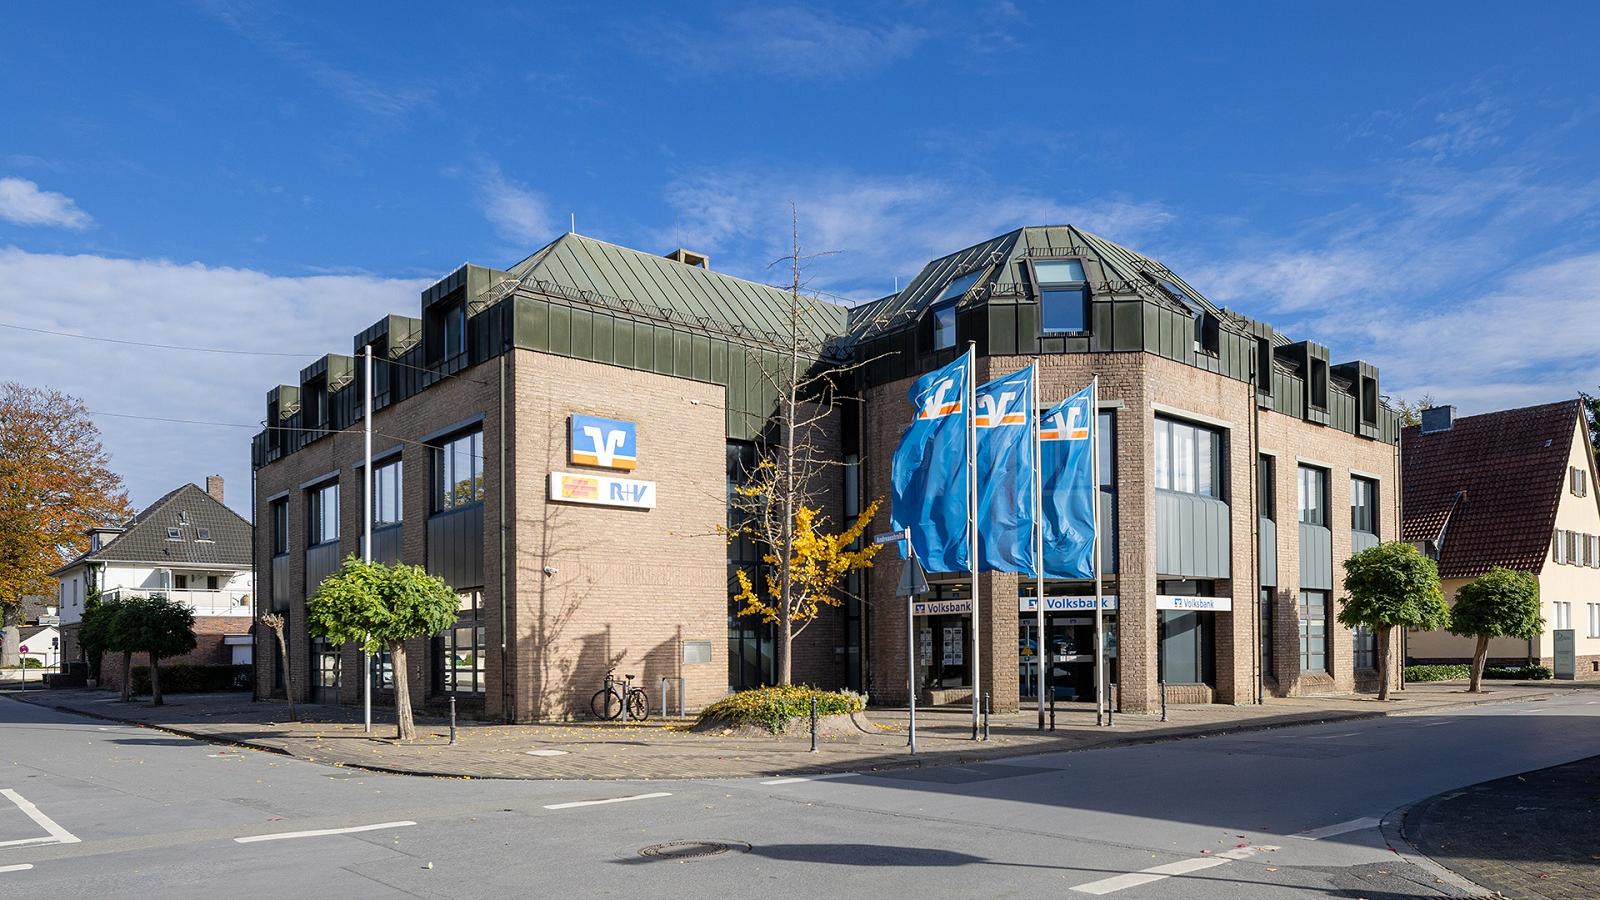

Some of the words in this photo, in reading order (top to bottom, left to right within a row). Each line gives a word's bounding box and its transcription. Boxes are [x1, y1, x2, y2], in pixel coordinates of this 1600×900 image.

[610, 482, 648, 502] R+V
[928, 601, 971, 613] Volksbank
[1184, 599, 1214, 608] Volksbank
